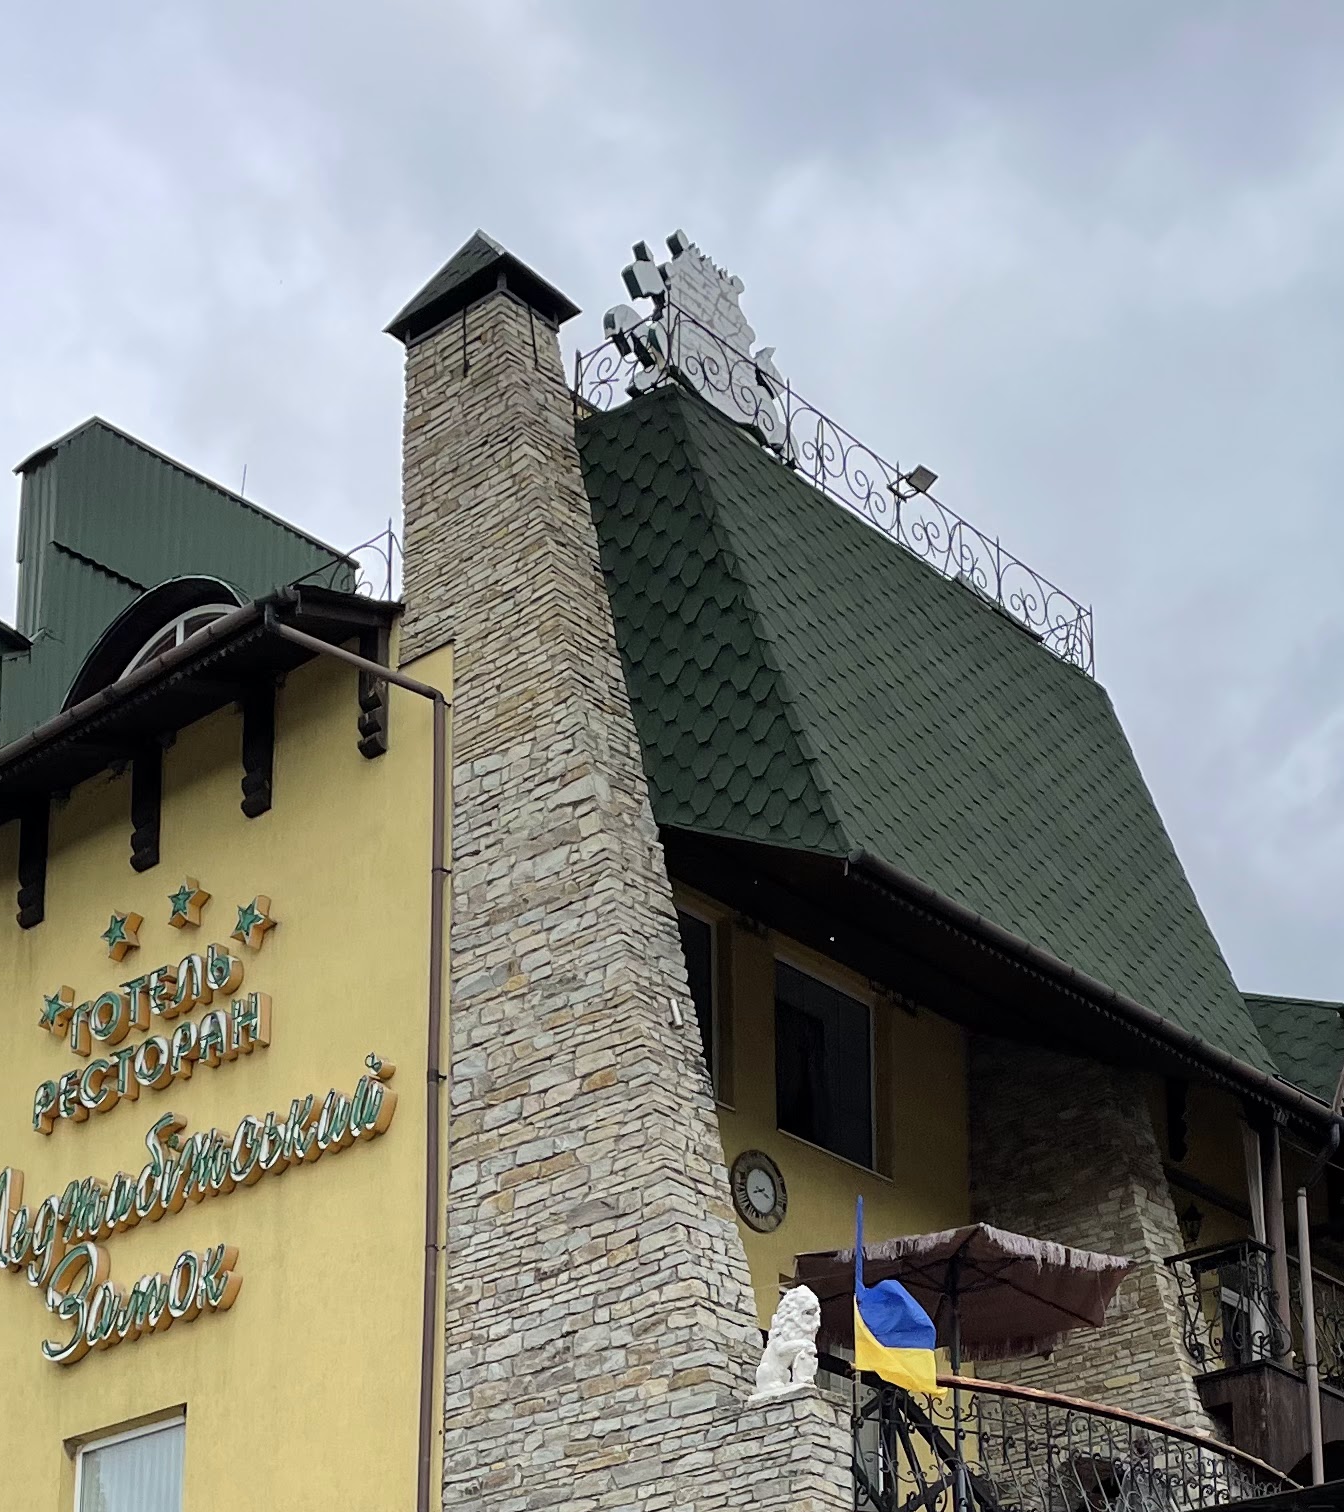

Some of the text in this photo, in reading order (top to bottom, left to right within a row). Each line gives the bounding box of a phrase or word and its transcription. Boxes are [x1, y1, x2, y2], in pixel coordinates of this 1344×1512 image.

[70, 942, 244, 1056] ГОТЕЛЬ
[32, 992, 272, 1134] РЕСТОРАН
[42, 1242, 243, 1364] Замок
